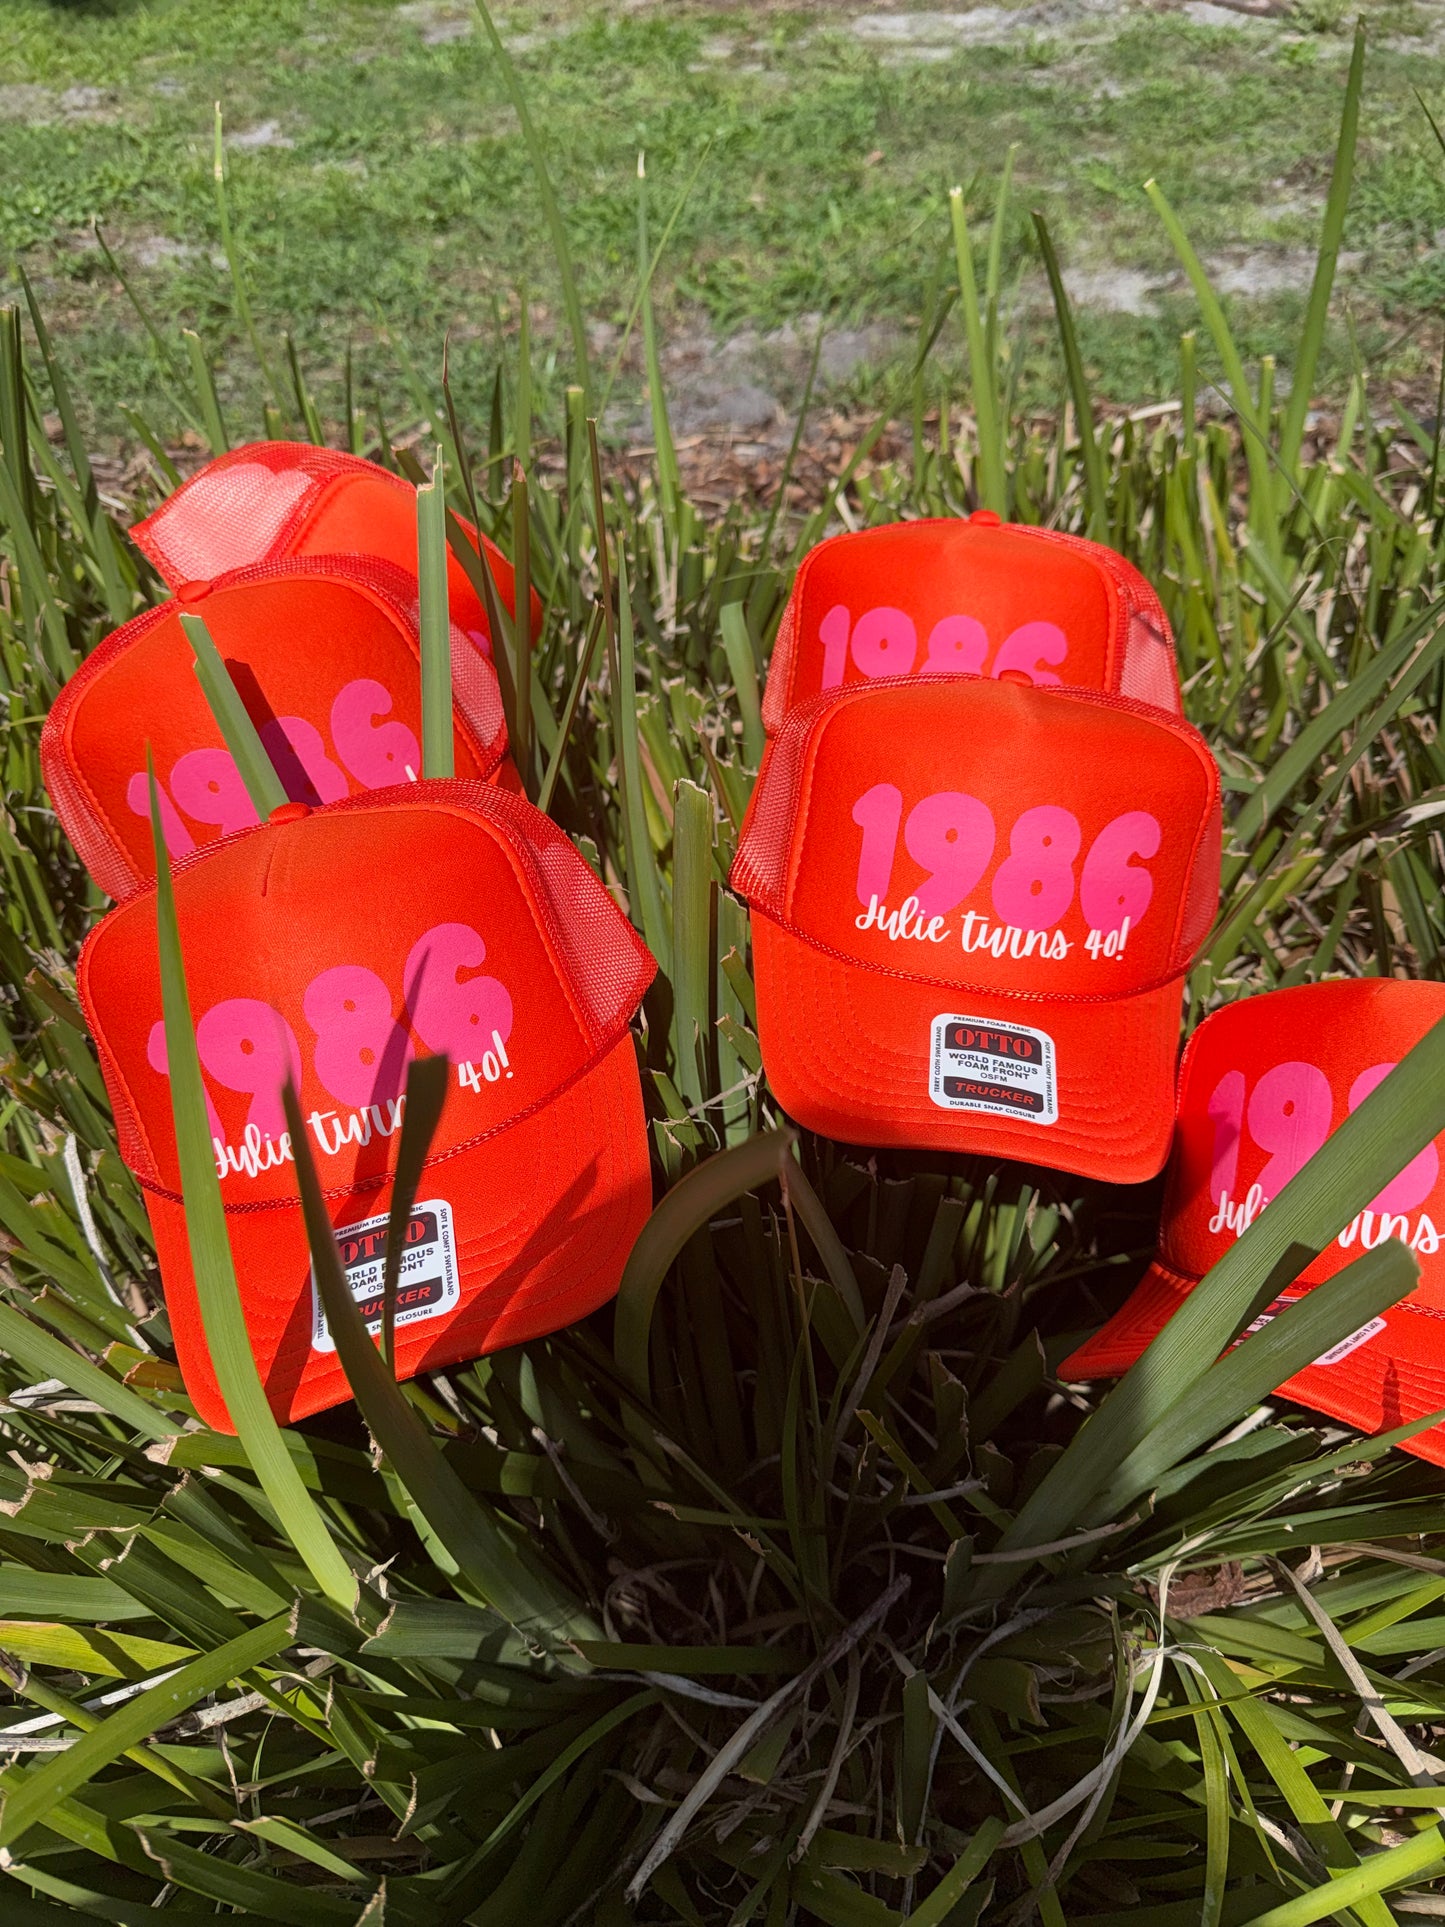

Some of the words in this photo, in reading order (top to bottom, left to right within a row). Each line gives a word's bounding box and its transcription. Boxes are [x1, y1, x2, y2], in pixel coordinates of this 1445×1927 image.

[852, 783, 1161, 936] 1986
[855, 894, 950, 943] Julie
[961, 910, 1074, 960] turns
[1084, 916, 1131, 961] 40!
[953, 1016, 985, 1024] PREMIUM
[987, 1020, 1007, 1028] FOAM
[1008, 1025, 1031, 1033] FABRIC
[955, 1028, 1033, 1057] OTTO
[458, 1030, 514, 1093] 40!
[949, 1052, 989, 1064] WORLD
[992, 1059, 1038, 1074] FAMOUS
[958, 1060, 989, 1071] FOAM
[993, 1066, 1030, 1080] FRONT
[980, 1072, 1008, 1082] OSFM
[955, 1082, 1034, 1105] TRUCKER
[949, 1100, 981, 1108] DURABLE
[1005, 1108, 1036, 1119] CLOSURE
[335, 1221, 370, 1238] PREMIUM
[339, 1220, 426, 1265] OTO
[442, 1231, 451, 1253] COMFY
[351, 1275, 377, 1290] OAM
[444, 1254, 455, 1296] SWEATBAND
[396, 1308, 433, 1322] CLOSURE
